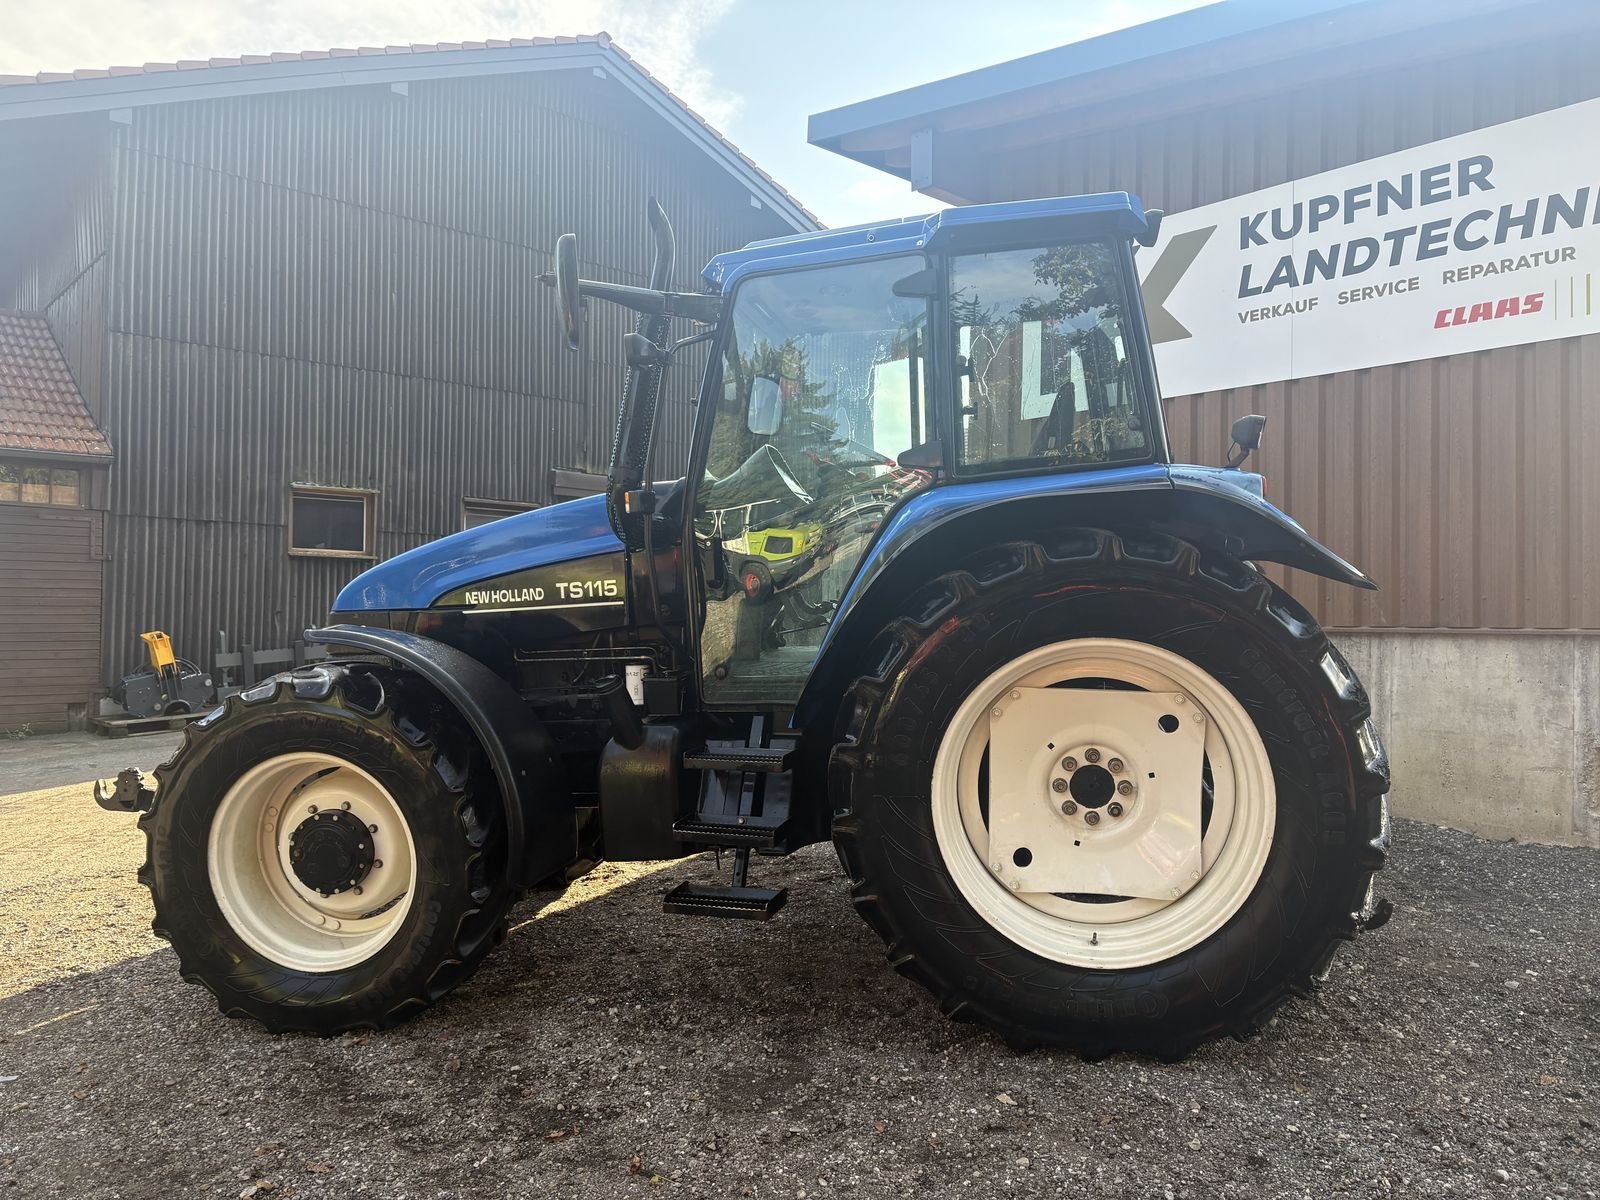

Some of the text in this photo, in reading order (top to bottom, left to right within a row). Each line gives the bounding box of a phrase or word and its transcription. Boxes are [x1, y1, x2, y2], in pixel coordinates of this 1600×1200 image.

[1240, 155, 1495, 250] KUPFNER
[1238, 247, 1577, 325] VERKAUF SERVICE REPARATUR
[1434, 292, 1545, 329] CLAAS
[465, 587, 545, 605] NEW HOLLAND
[556, 579, 618, 599] TS115
